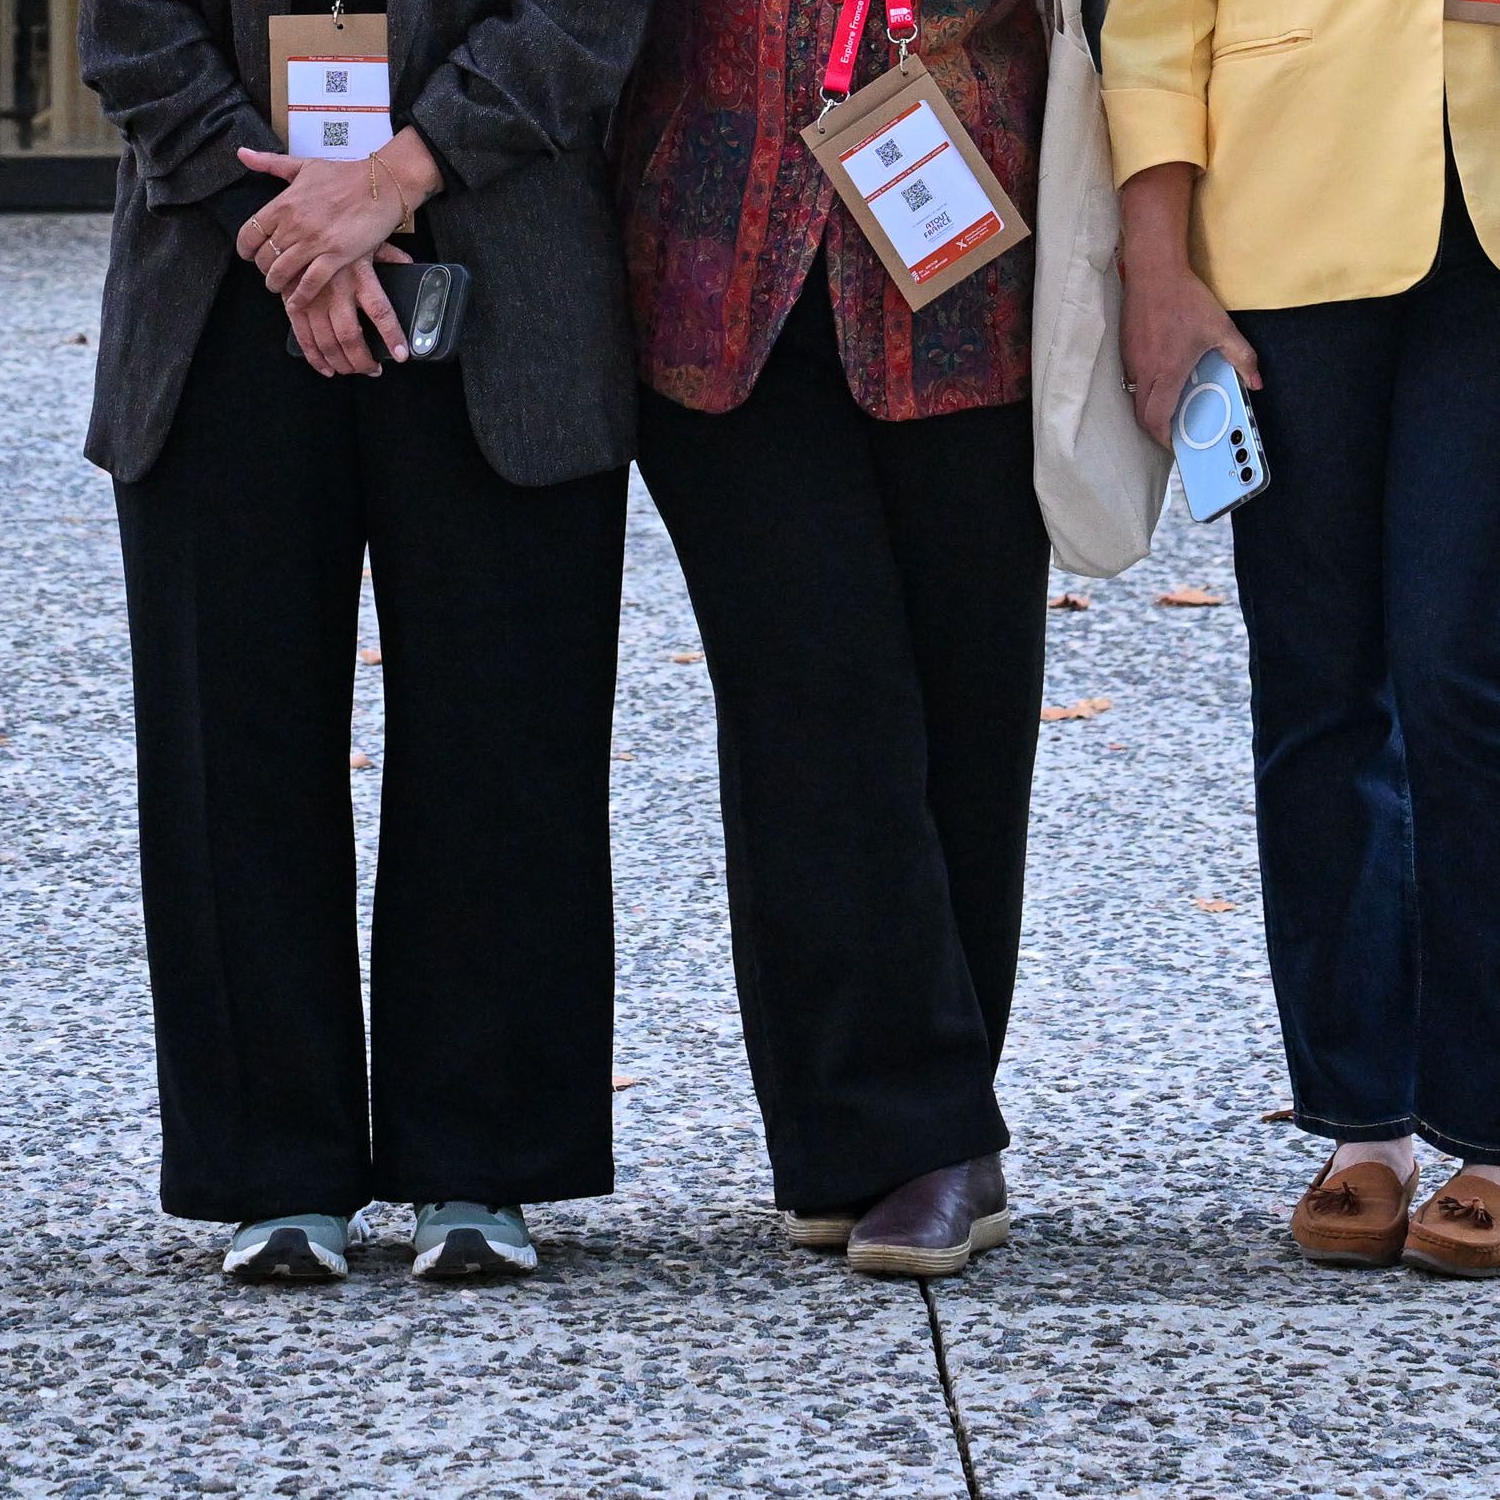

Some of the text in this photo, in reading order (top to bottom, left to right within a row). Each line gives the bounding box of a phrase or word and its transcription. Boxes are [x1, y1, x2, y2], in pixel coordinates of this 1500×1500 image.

[840, 29, 856, 64] Explore
[923, 216, 953, 240] FRANCE
[925, 211, 948, 230] ATOUT
